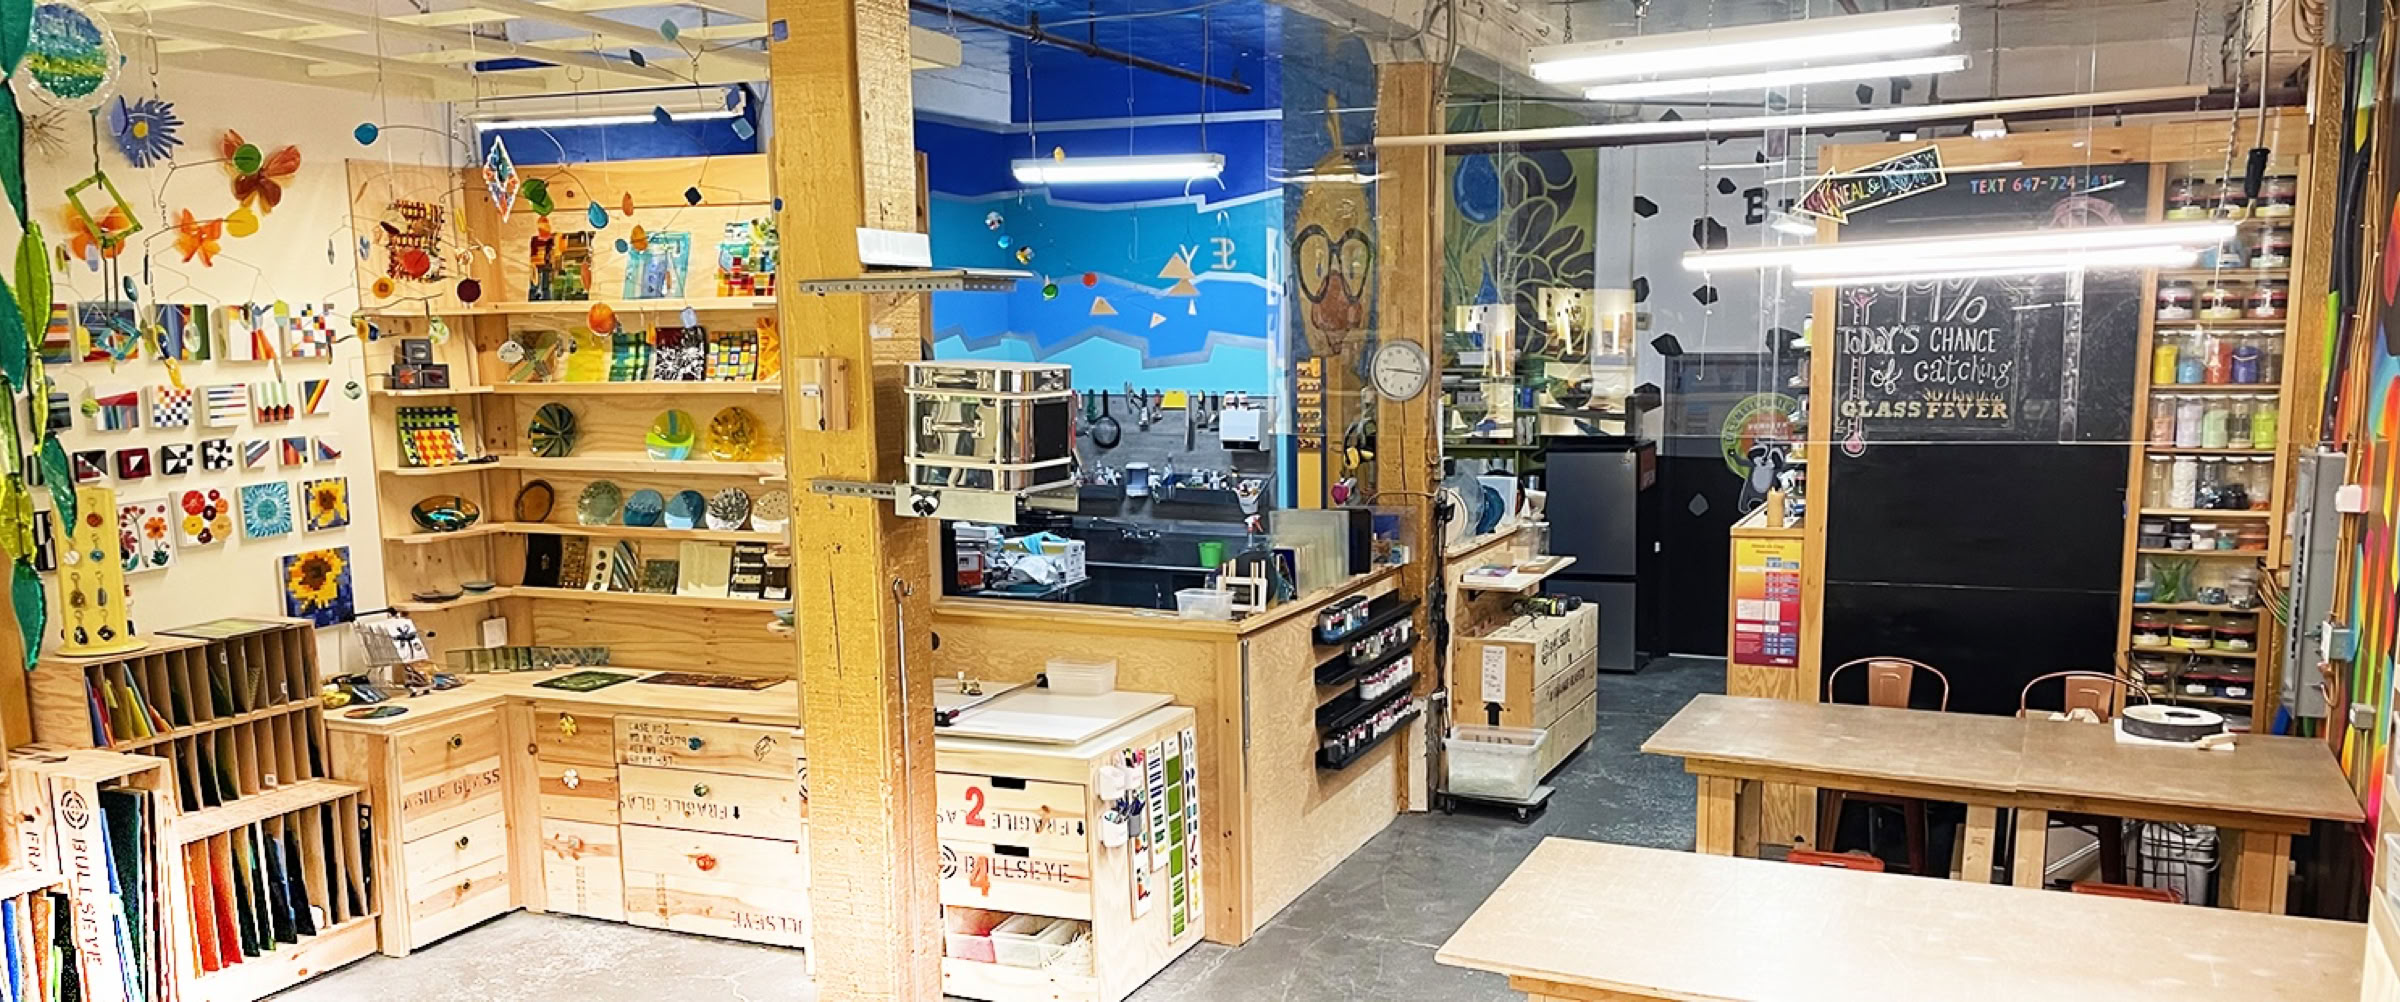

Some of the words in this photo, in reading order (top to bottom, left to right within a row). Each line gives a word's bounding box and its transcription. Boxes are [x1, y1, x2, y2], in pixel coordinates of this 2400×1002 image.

[1970, 177, 2006, 194] TEXT
[1929, 327, 2000, 353] CHANCE
[1869, 357, 1903, 394] of
[1913, 354, 2012, 389] catching
[1840, 400, 1921, 418] GLASS
[1926, 402, 2008, 419] FEVER
[453, 767, 501, 799] GLASS
[663, 797, 728, 820] FRAGILE
[965, 786, 986, 827] 2
[991, 812, 1070, 836] FRAGILE
[970, 855, 991, 896] 4
[71, 837, 102, 966] BULLSEYE
